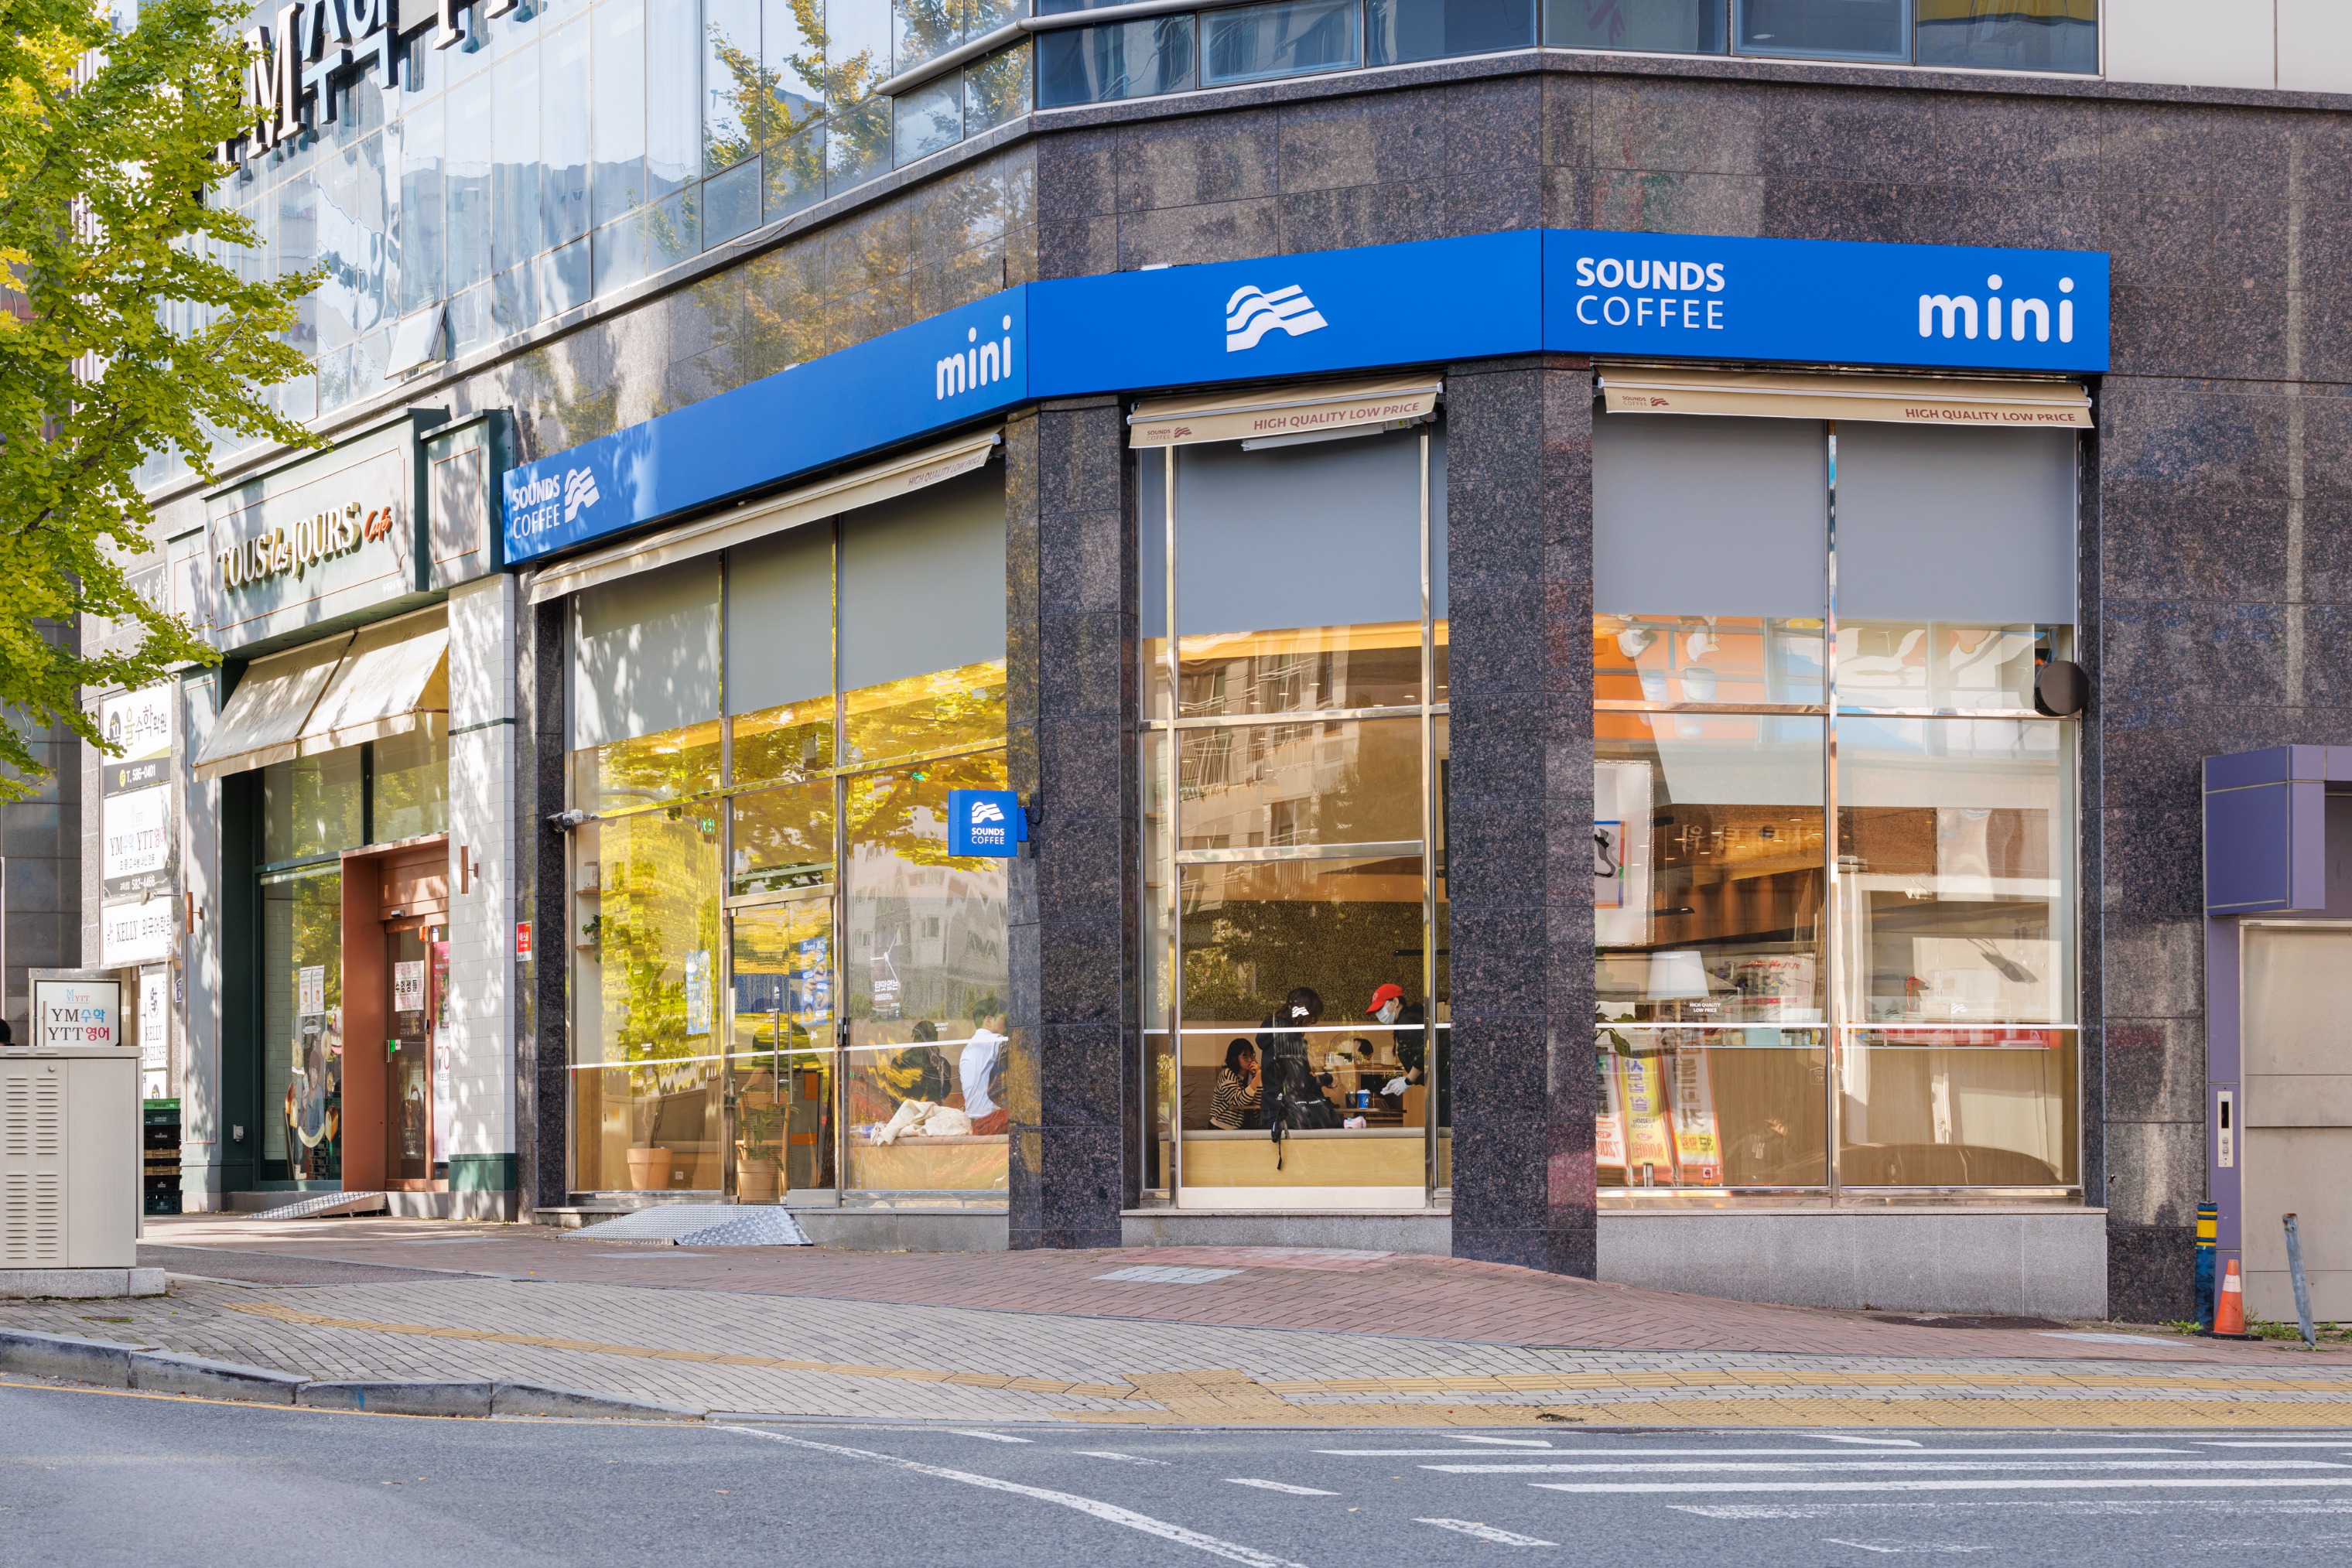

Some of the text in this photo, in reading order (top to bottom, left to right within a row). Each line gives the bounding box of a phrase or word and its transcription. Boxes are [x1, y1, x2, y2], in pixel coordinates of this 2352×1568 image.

[1576, 257, 1725, 292] SOUNDS
[1576, 295, 1725, 330] COFFEE
[1919, 274, 2075, 343] mini
[936, 315, 1011, 401] mini
[1253, 401, 1420, 431] HIGH QUALITY LOW PRICE
[1905, 408, 2076, 422] HIGH QUALITY LOW PRICE
[908, 454, 983, 487] HIGH QUALITY LOW PRICE
[512, 474, 560, 511] SOUNDS
[513, 503, 560, 539] COFFEE
[217, 532, 271, 593] TOUS
[270, 528, 292, 574] les
[291, 502, 361, 579] JOURS
[971, 827, 1004, 835] SOUNDS
[971, 836, 1004, 845] COFFEE
[117, 921, 138, 942] KELLY
[874, 979, 898, 992] 탄맛없는
[51, 1009, 105, 1023] YM수학
[47, 1027, 110, 1041] YTT영어
[145, 1026, 162, 1041] KELLY
